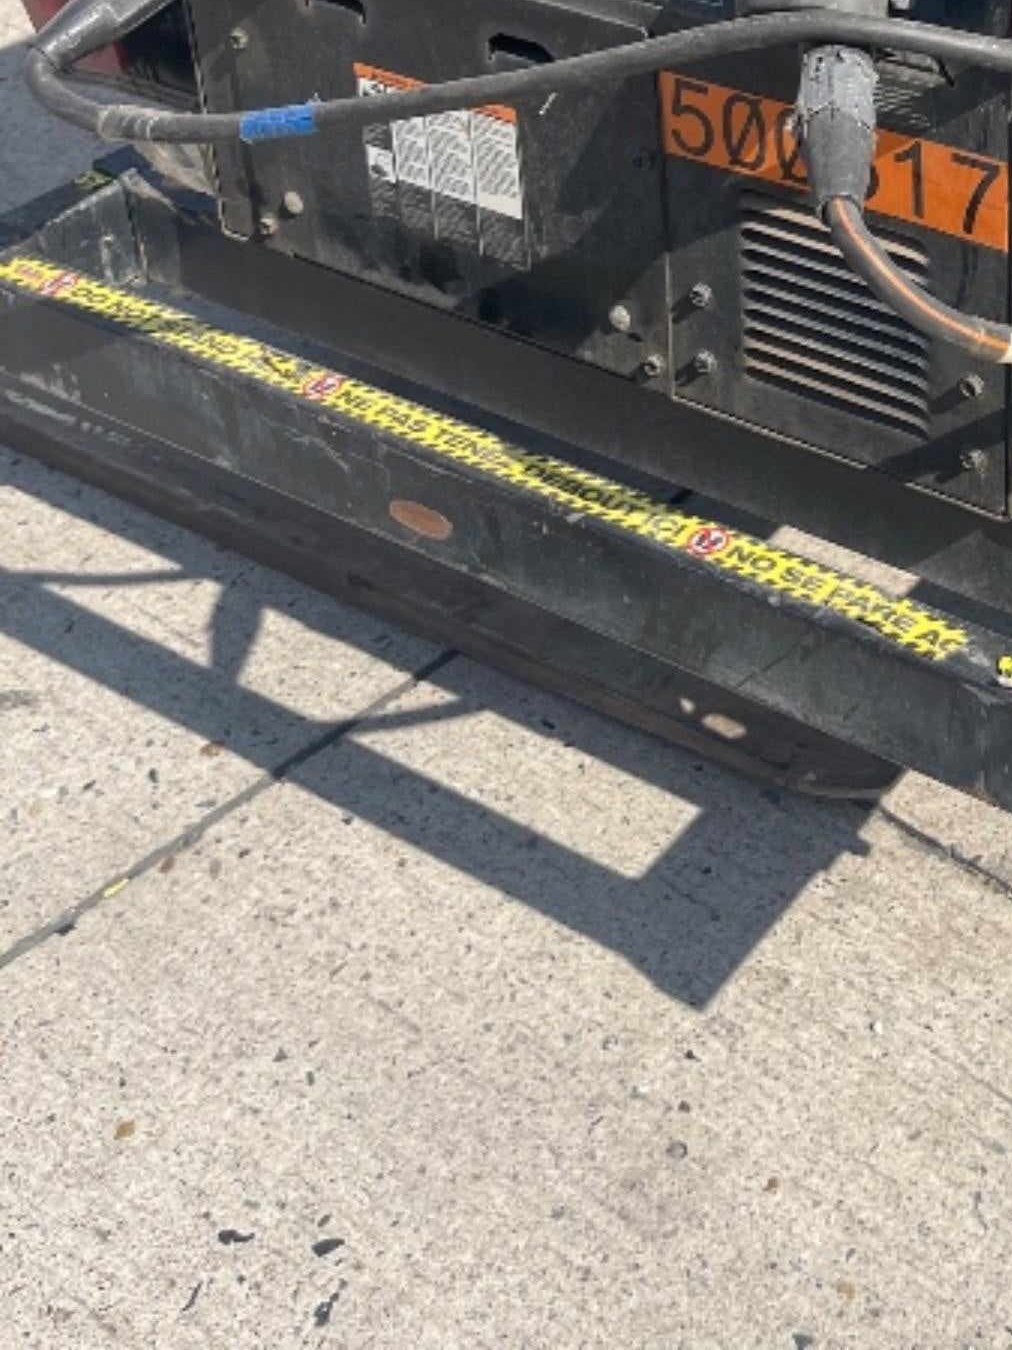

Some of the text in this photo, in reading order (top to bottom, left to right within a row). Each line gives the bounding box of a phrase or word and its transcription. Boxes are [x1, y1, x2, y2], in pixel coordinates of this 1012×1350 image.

[671, 77, 1000, 236] 50017
[337, 388, 375, 412] NE
[375, 404, 430, 436] PAS
[521, 462, 640, 518] DEBOUT
[726, 543, 778, 576] NO
[780, 564, 825, 595] SE
[828, 585, 916, 634] PARE
